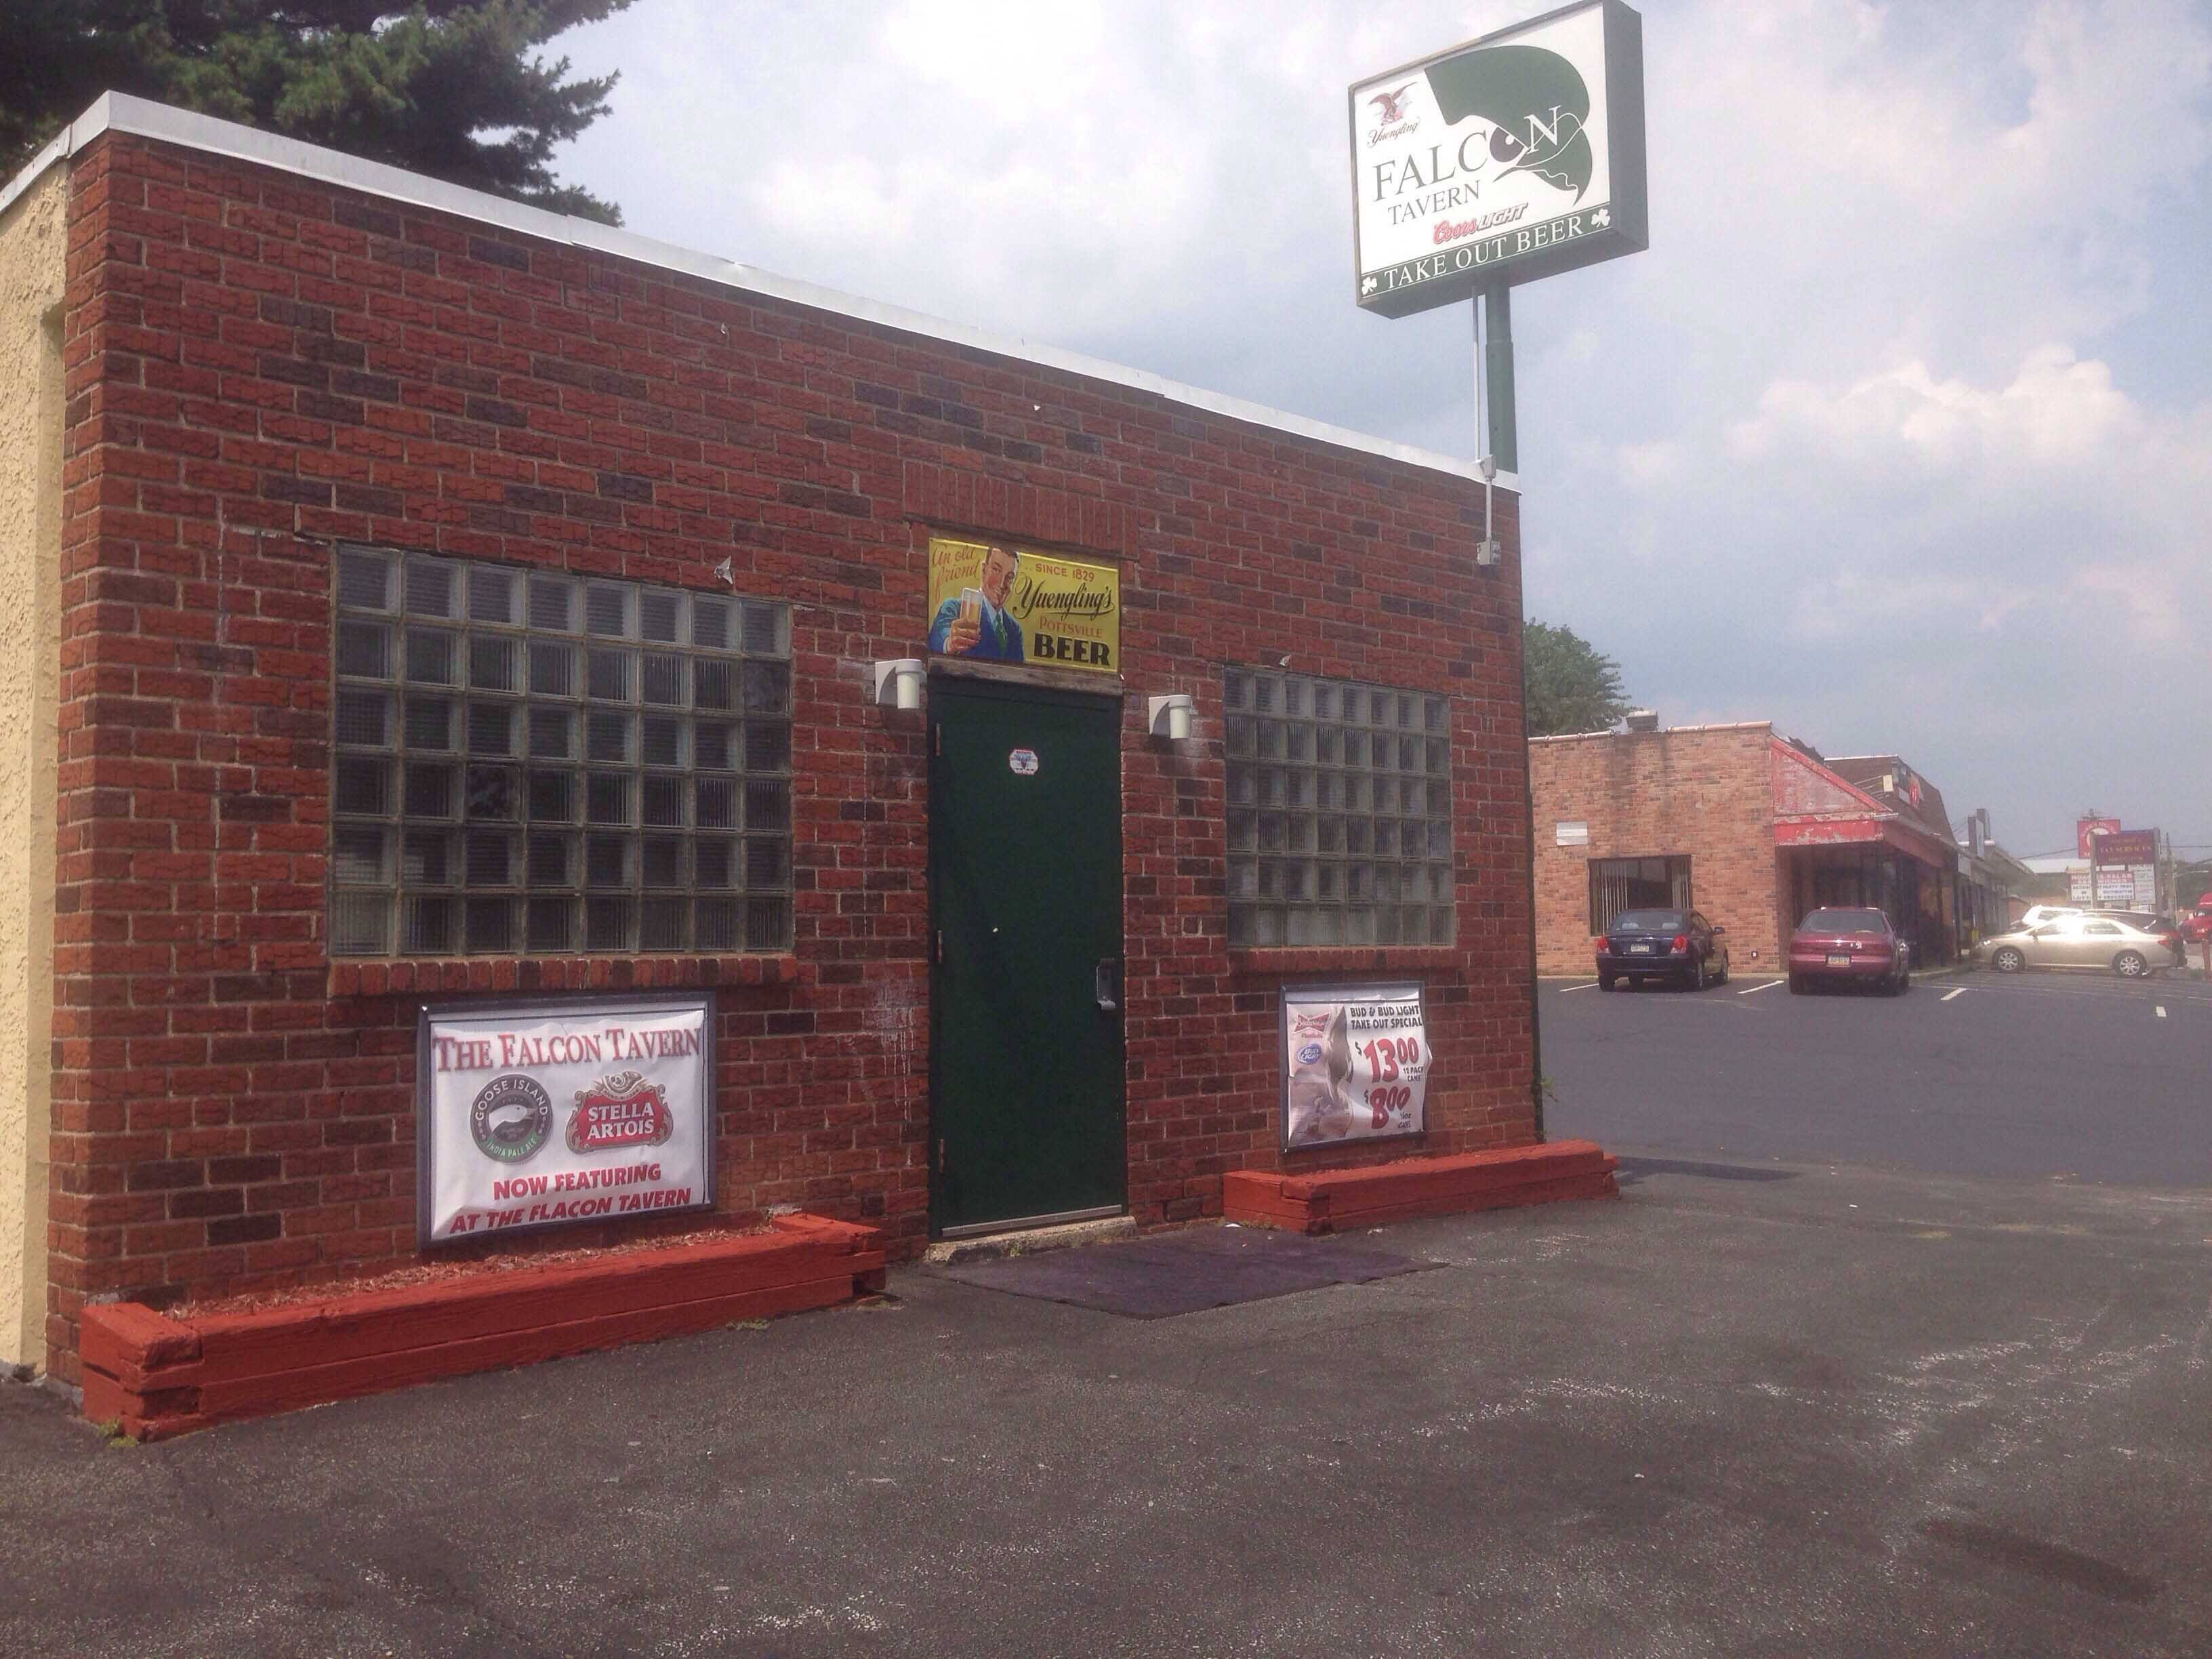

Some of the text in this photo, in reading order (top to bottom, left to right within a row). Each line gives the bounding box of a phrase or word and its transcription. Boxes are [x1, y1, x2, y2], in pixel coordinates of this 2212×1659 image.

[1367, 116, 1420, 148] Yuengling
[1387, 180, 1481, 226] TAVERN
[1433, 202, 1528, 245] Coors LIGHT
[1384, 216, 1584, 290] TAKE OUT BEER
[1035, 563, 1095, 581] SINCE 1829
[1012, 572, 1115, 621] Yuengling's
[1039, 617, 1103, 638] POTTSVILLE
[1033, 632, 1110, 666] BEER
[1350, 1005, 1420, 1017] BUD & BUD LIGHT
[1351, 1017, 1423, 1030] TAKE OUT SPECIAL
[433, 1027, 701, 1073] THE FALCON TAVERN
[475, 1078, 548, 1120] GOOSE ISLAND
[588, 1101, 655, 1122] STELLA
[587, 1118, 655, 1139] ARTOIS
[487, 1136, 538, 1158] INDIA PALE ALE
[493, 1163, 661, 1200] NOW FEATURING
[449, 1187, 691, 1233] AT THE FLACON TAVERN
